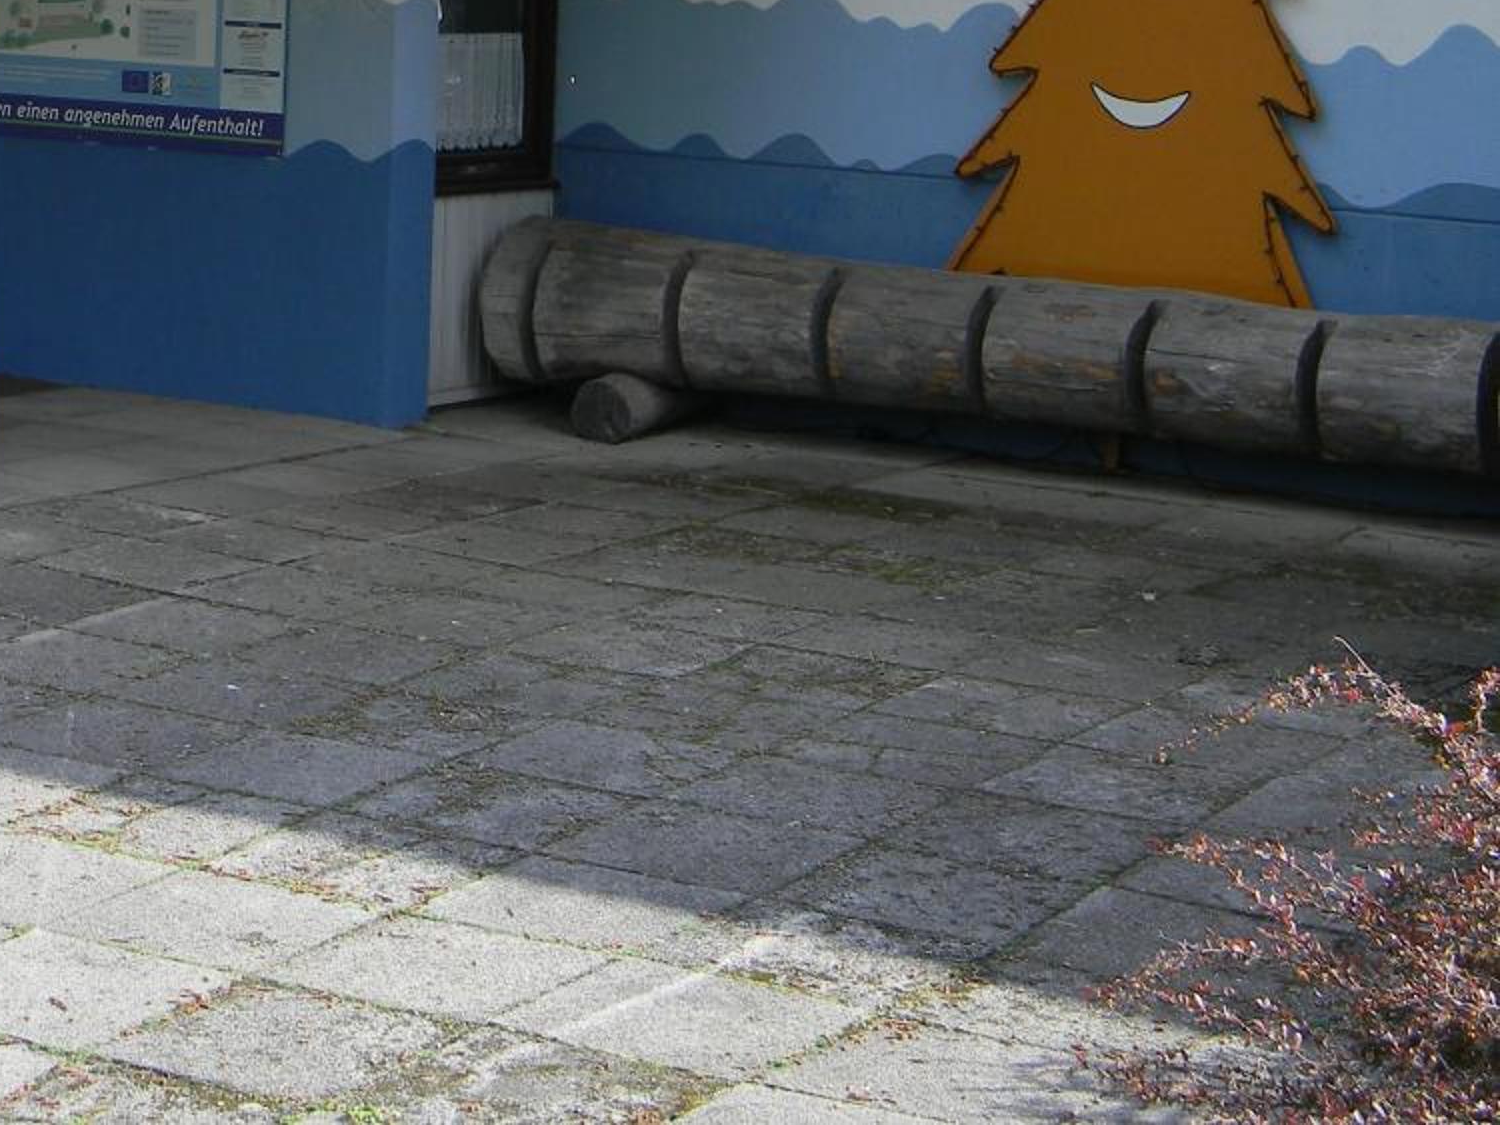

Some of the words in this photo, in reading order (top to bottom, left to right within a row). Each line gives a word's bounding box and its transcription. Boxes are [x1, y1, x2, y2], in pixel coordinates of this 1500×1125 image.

[16, 101, 60, 121] einen
[64, 106, 166, 129] angenehmen
[168, 111, 264, 137] Aufenthalt!
